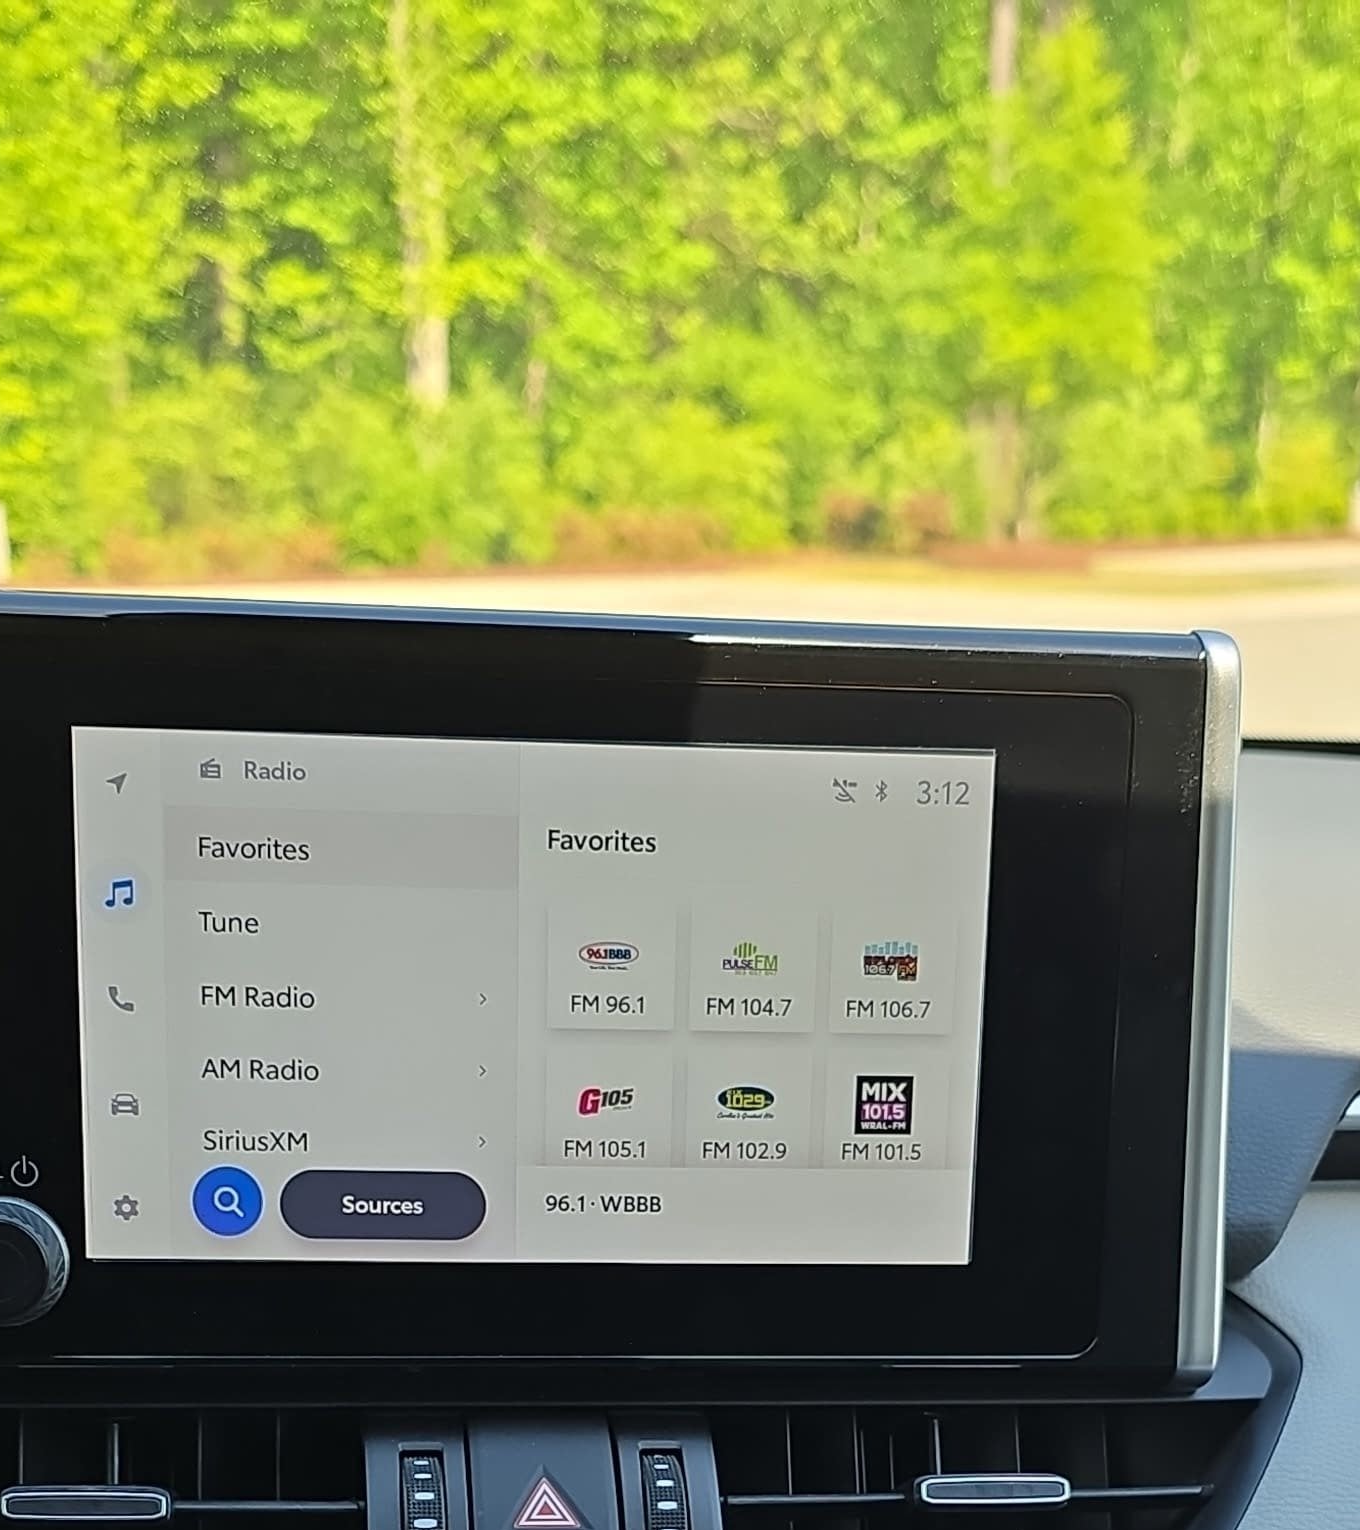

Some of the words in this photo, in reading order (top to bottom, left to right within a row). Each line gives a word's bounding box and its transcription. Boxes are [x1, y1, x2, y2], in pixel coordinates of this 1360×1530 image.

[243, 760, 307, 783] Radio
[916, 780, 971, 806] 3:12
[197, 835, 311, 862] Favorites
[547, 828, 657, 855] Favorites
[198, 911, 260, 935] Tune
[200, 985, 237, 1009] FM
[244, 985, 316, 1011] Radio
[571, 995, 599, 1013] FM
[606, 996, 645, 1014] 96.1
[706, 997, 735, 1015] FM
[740, 998, 792, 1017] 104.7
[846, 1000, 874, 1018] FM
[880, 1000, 931, 1019] 106.7
[200, 1058, 242, 1081] AM
[248, 1058, 320, 1083] Radio
[861, 1082, 908, 1102] MIX
[861, 1103, 906, 1120] 101.5
[202, 1128, 309, 1154] SiriusXM
[564, 1140, 593, 1158] FM
[599, 1140, 646, 1159] 105.1
[702, 1141, 730, 1159] FM
[737, 1142, 787, 1160] 102.9
[841, 1142, 869, 1161] FM
[875, 1142, 922, 1161] 101.5
[341, 1193, 424, 1216] Sources
[600, 1194, 663, 1214] WBBB
